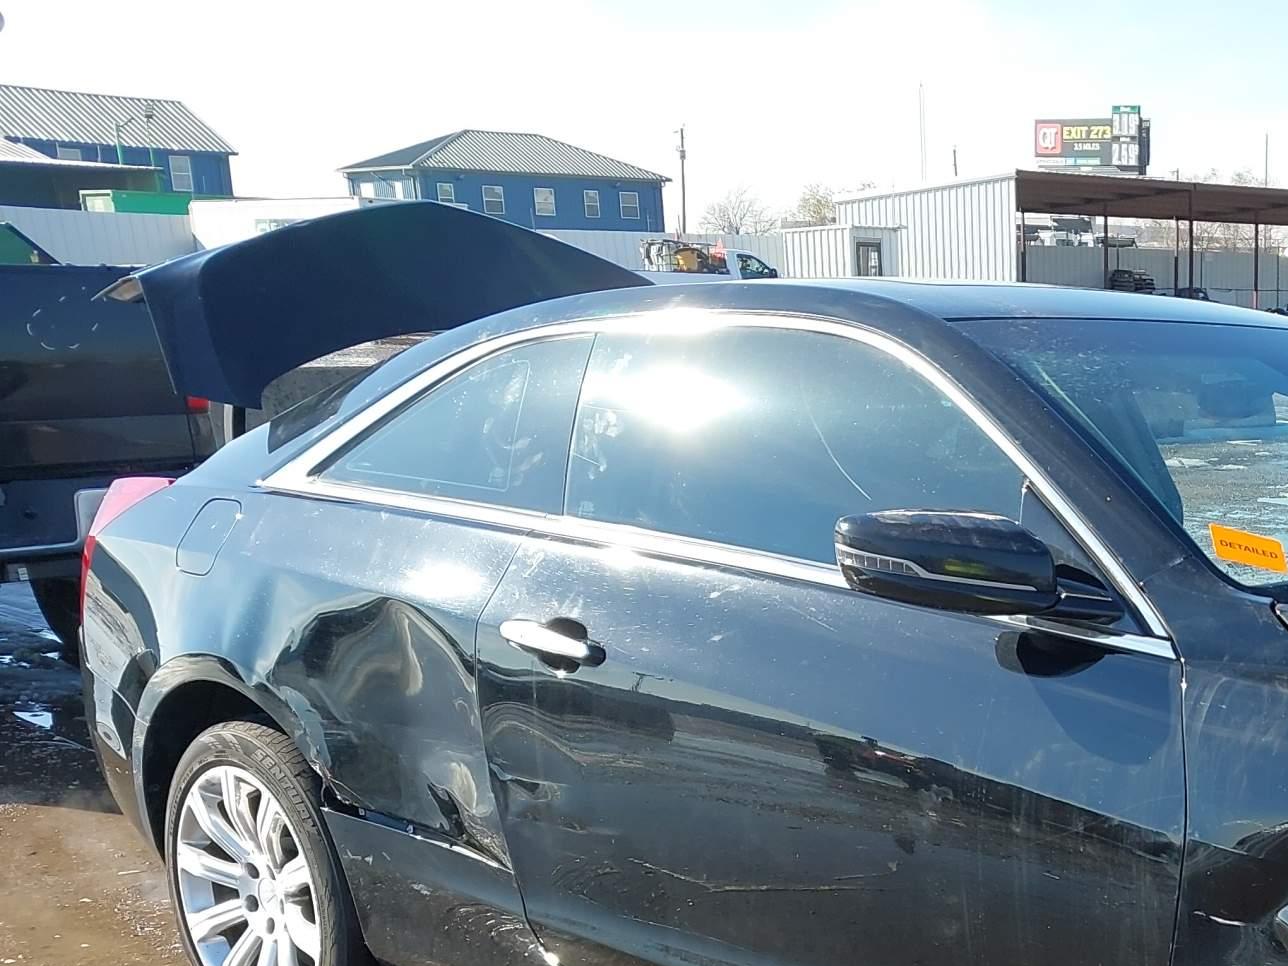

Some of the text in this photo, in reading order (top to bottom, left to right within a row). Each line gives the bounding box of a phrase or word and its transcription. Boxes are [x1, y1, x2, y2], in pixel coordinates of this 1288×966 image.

[1039, 127, 1058, 150] QT
[1062, 125, 1112, 139] EXIT 273
[1219, 539, 1278, 559] DETAILED
